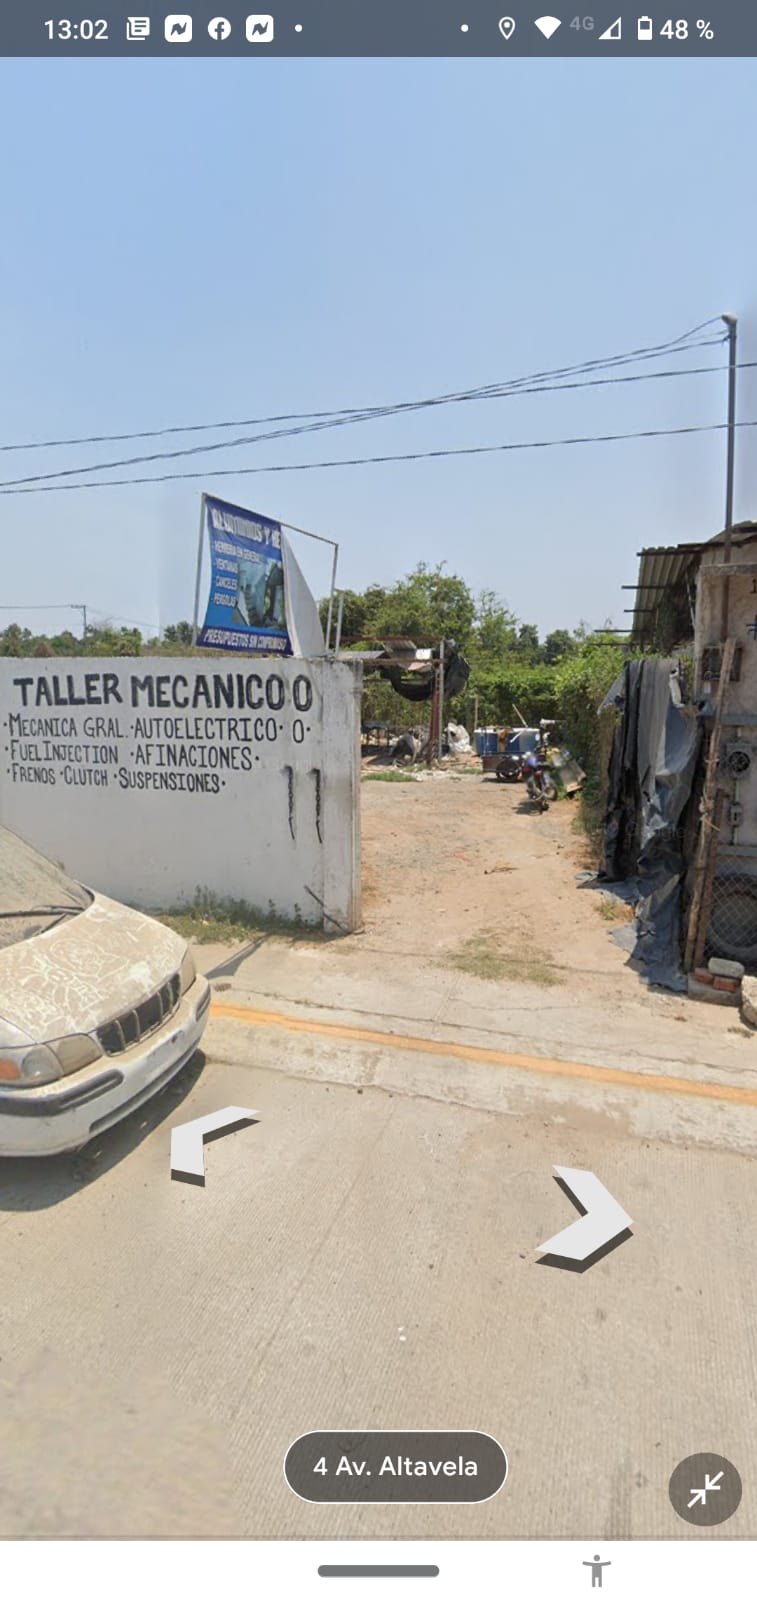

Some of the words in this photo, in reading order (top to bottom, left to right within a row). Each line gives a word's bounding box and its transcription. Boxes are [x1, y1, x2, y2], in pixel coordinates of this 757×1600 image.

[13, 674, 123, 707] TALLER
[130, 673, 285, 711] MECANICO
[9, 713, 78, 737] MECANICA
[134, 718, 278, 742] AUTOELECTRICO
[135, 747, 253, 771] AFINACIONES
[12, 764, 56, 785] FRENOS
[63, 766, 108, 787] CLUTCH
[119, 767, 221, 794] SUSPENSIONES
